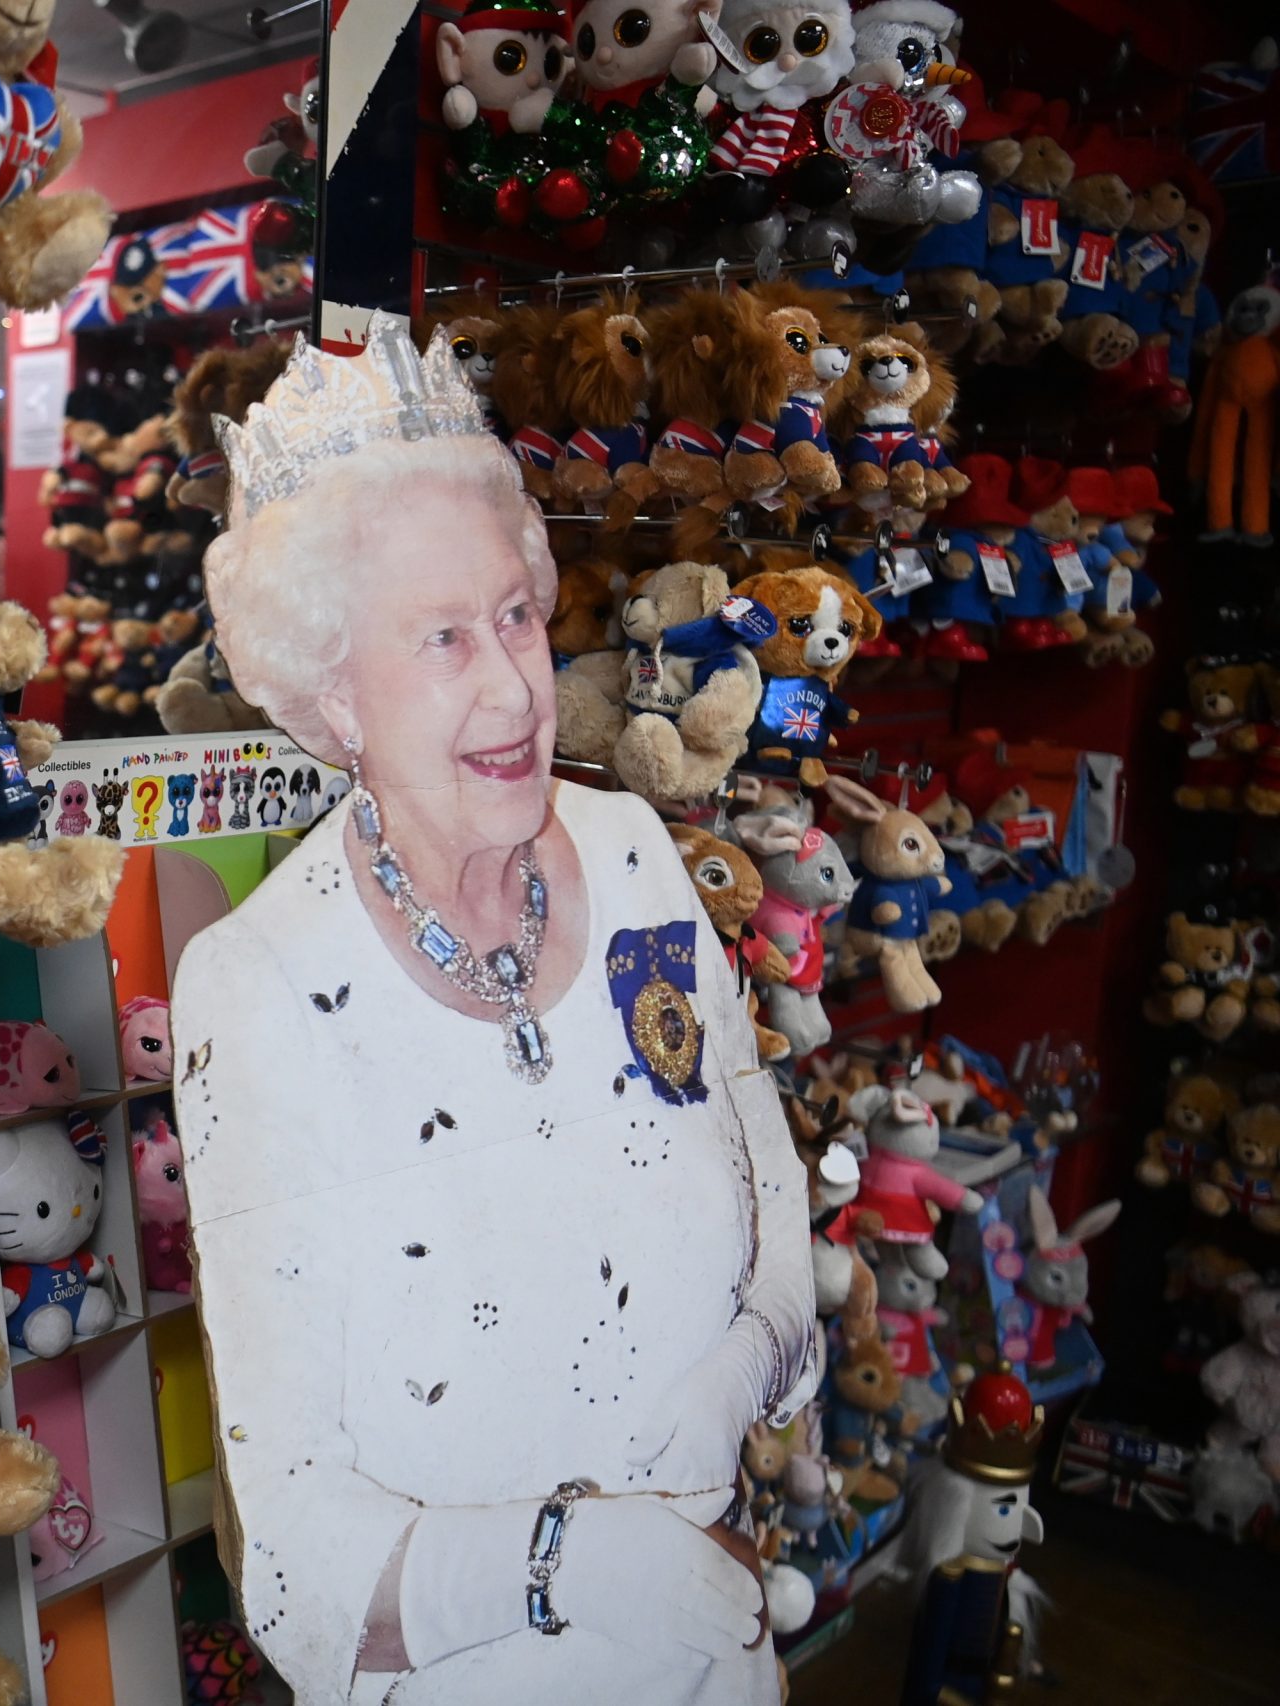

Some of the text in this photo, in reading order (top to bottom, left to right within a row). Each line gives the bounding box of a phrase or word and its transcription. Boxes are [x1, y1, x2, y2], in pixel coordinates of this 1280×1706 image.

[777, 690, 826, 713] LONDON
[37, 760, 91, 773] Collectibles
[122, 752, 150, 768] HAND
[204, 748, 230, 764] MINI
[48, 1282, 86, 1303] LONDON
[52, 1274, 63, 1288] I
[51, 1514, 84, 1545] ty
